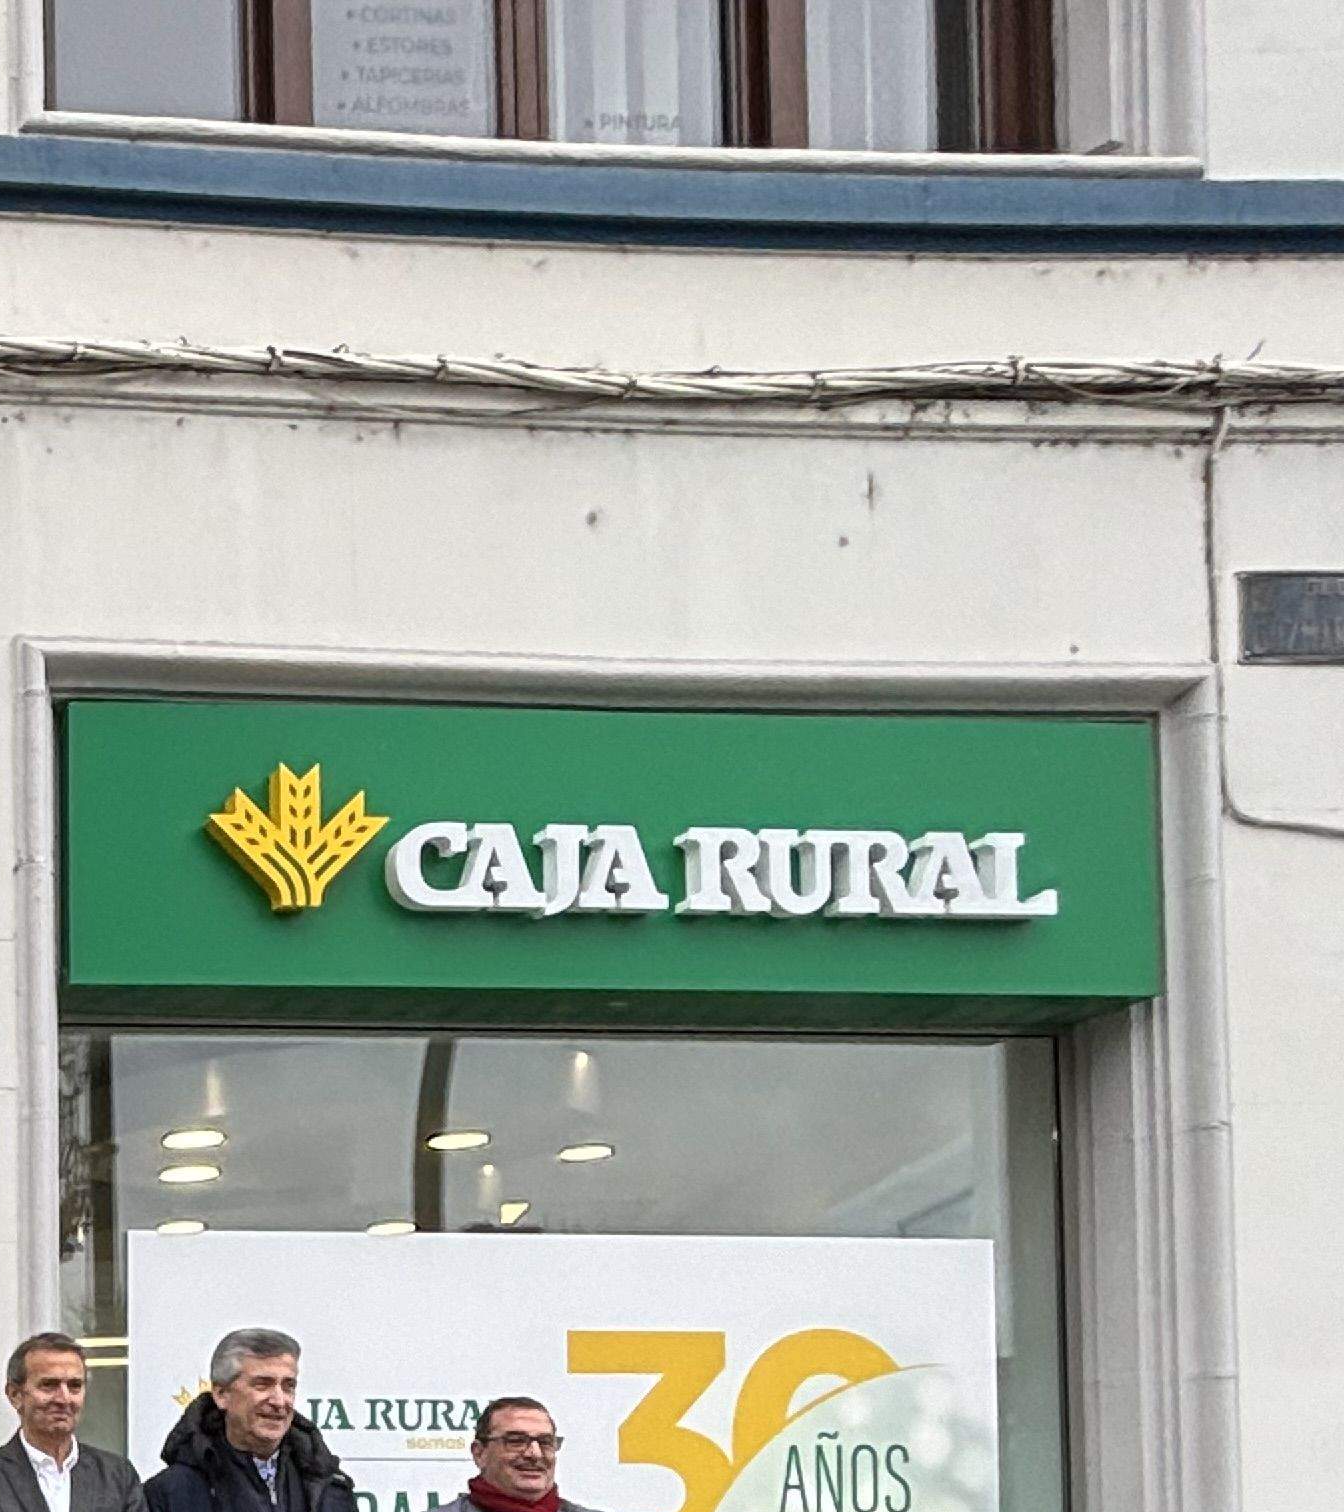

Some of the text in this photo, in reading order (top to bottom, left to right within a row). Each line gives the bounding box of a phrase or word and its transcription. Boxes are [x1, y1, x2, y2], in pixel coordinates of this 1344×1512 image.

[386, 821, 1059, 921] CAJA RURAL
[364, 1398, 484, 1431] RURA
